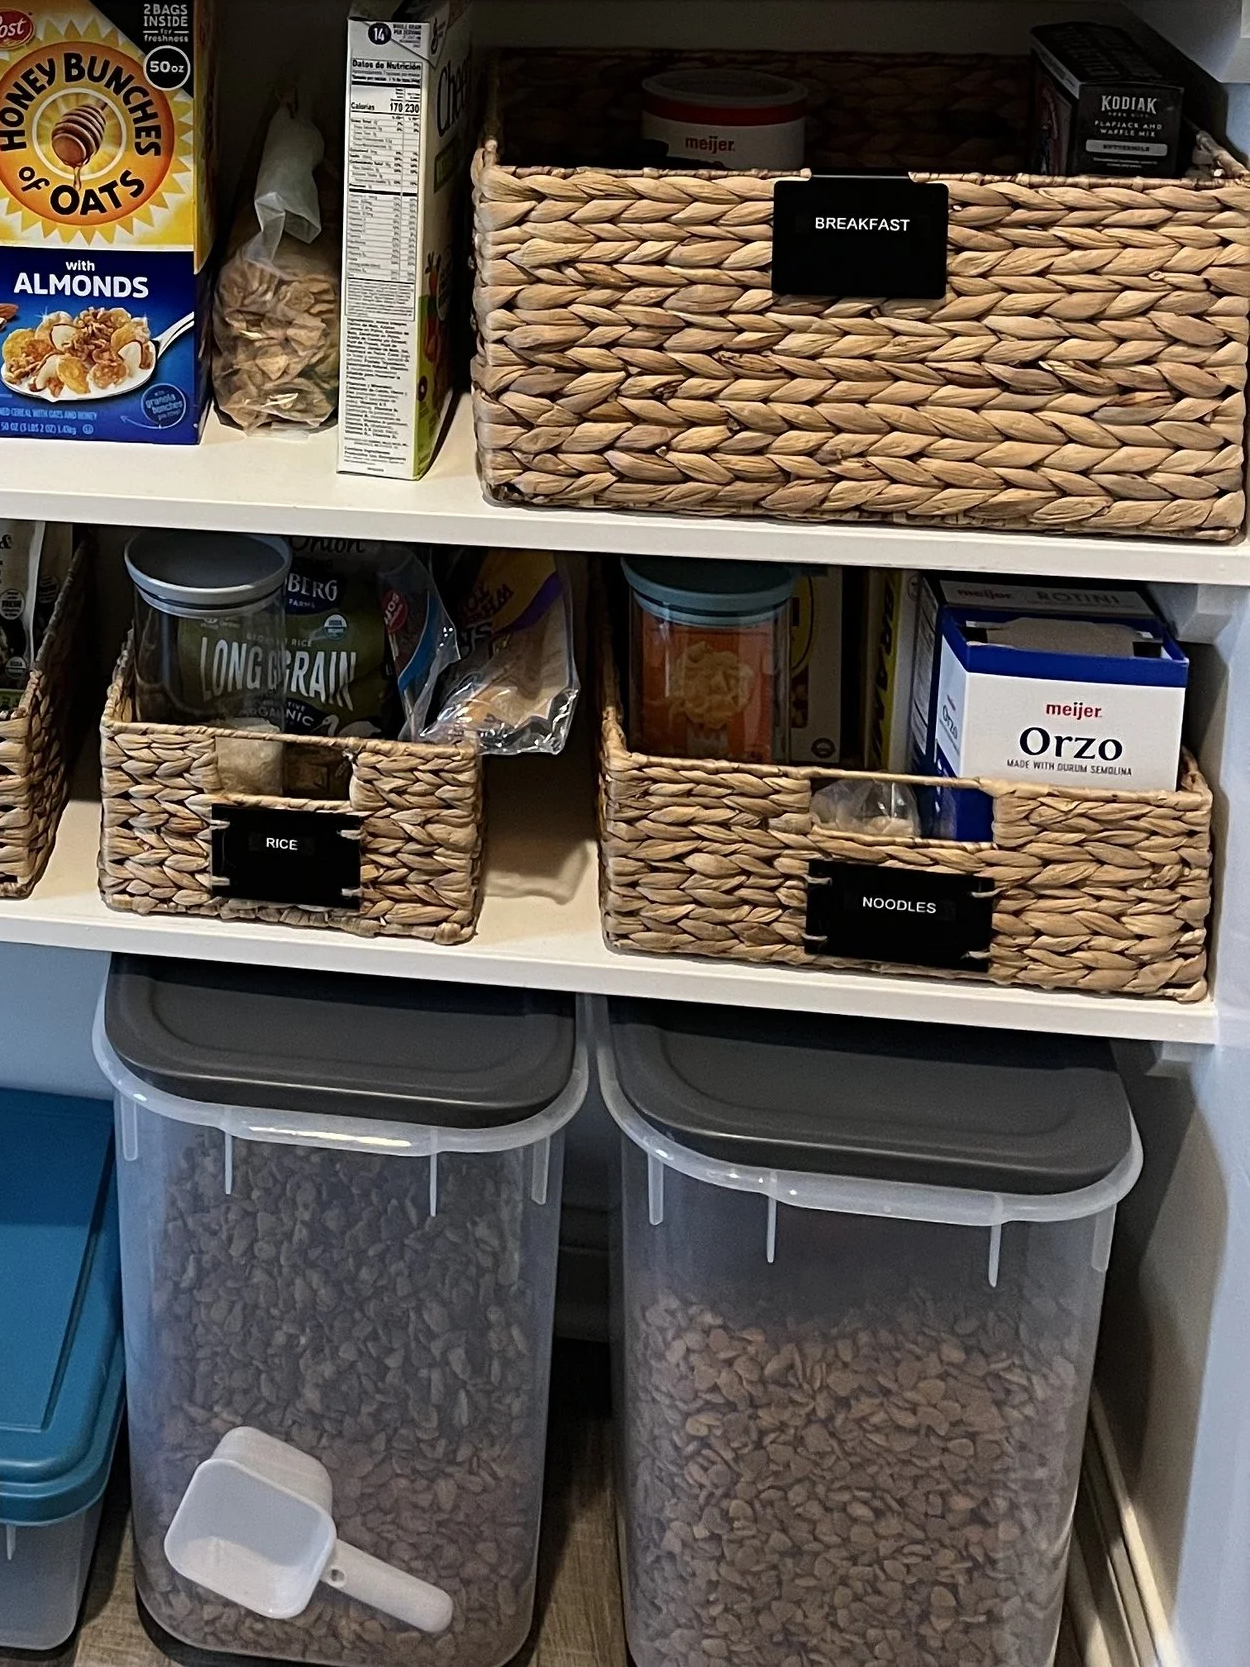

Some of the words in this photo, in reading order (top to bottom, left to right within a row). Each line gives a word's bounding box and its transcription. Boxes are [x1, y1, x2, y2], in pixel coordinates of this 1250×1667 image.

[144, 4, 151, 15] 2
[153, 4, 188, 15] BAGS
[144, 16, 188, 27] INSIDE
[144, 34, 189, 42] freshness
[373, 27, 385, 42] 14
[352, 59, 374, 69] Datos
[375, 60, 385, 69] de
[63, 52, 162, 157] BUNCHES
[390, 102, 403, 113] 170
[404, 102, 420, 113] 230
[1101, 95, 1157, 115] KODIAK
[685, 136, 736, 154] meijer
[18, 166, 50, 192] of
[50, 169, 146, 216] OATS
[814, 216, 911, 232] BREAKFAST
[65, 260, 96, 272] with
[13, 272, 149, 299] ALMONDS
[291, 639, 312, 647] RICE
[201, 636, 263, 702] LONG
[1046, 701, 1101, 720] meijer
[1019, 726, 1123, 762] Orzo
[1007, 759, 1029, 769] MADE
[1033, 760, 1055, 771] WITH
[1057, 762, 1088, 773] DURUM
[1091, 764, 1133, 776] SEMOLINA
[265, 836, 299, 851] RICE
[861, 896, 937, 915] NOODLES
